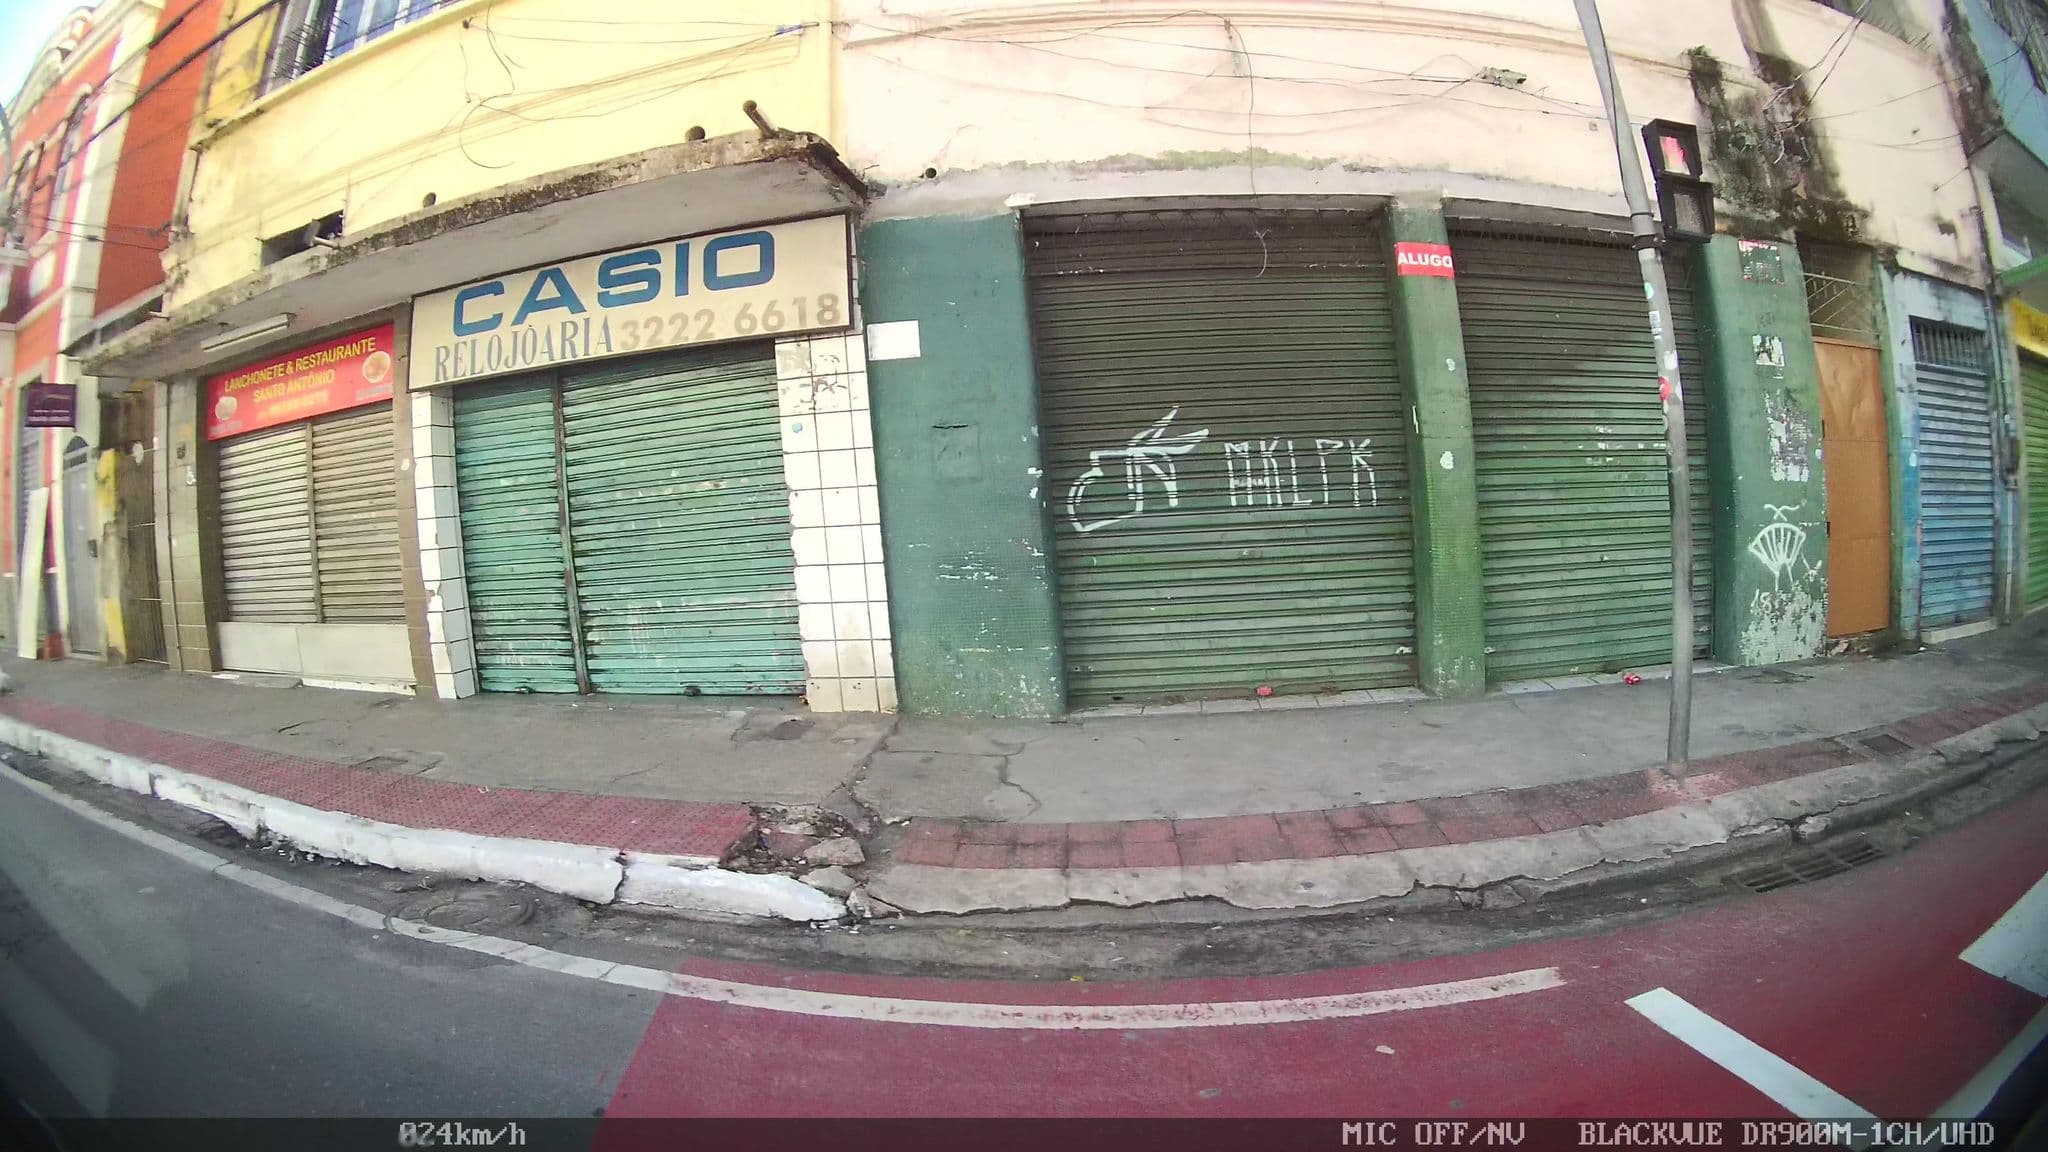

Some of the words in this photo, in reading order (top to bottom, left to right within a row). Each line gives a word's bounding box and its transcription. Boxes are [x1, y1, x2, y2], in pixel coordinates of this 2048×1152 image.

[453, 230, 775, 337] CASIO
[1397, 251, 1453, 268] ALUGO
[620, 308, 716, 351] 3222
[734, 293, 841, 335] 6618
[224, 363, 285, 393] LANCHONETE
[286, 361, 294, 374] &
[295, 337, 377, 372] RESTAURANTE
[253, 381, 286, 403] SANTO
